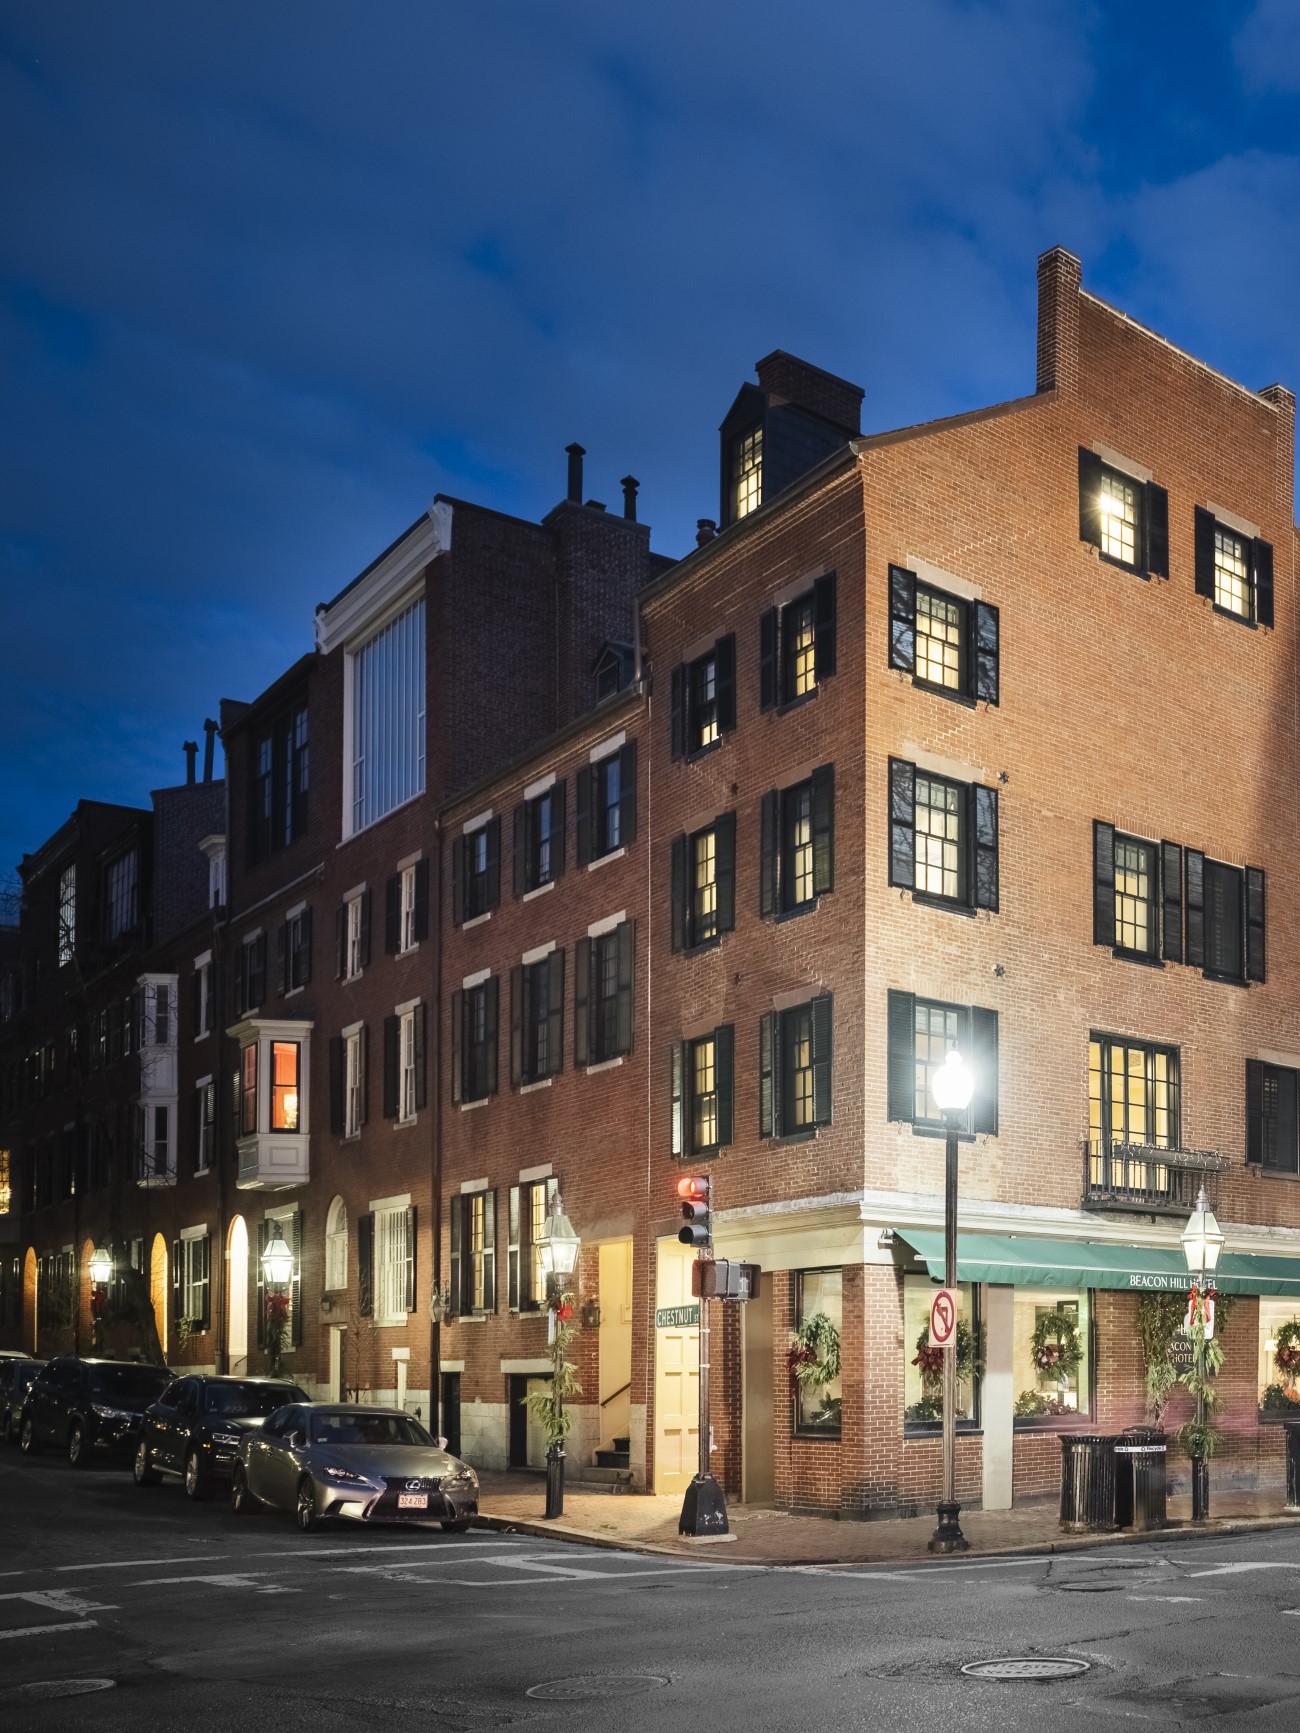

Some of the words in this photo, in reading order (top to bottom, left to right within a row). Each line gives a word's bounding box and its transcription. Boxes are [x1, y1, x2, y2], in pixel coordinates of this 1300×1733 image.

[1130, 1275, 1168, 1288] BEACON
[1170, 1277, 1188, 1289] HILL
[1190, 1278, 1218, 1290] HEL
[657, 1307, 693, 1327] CHESTNUT
